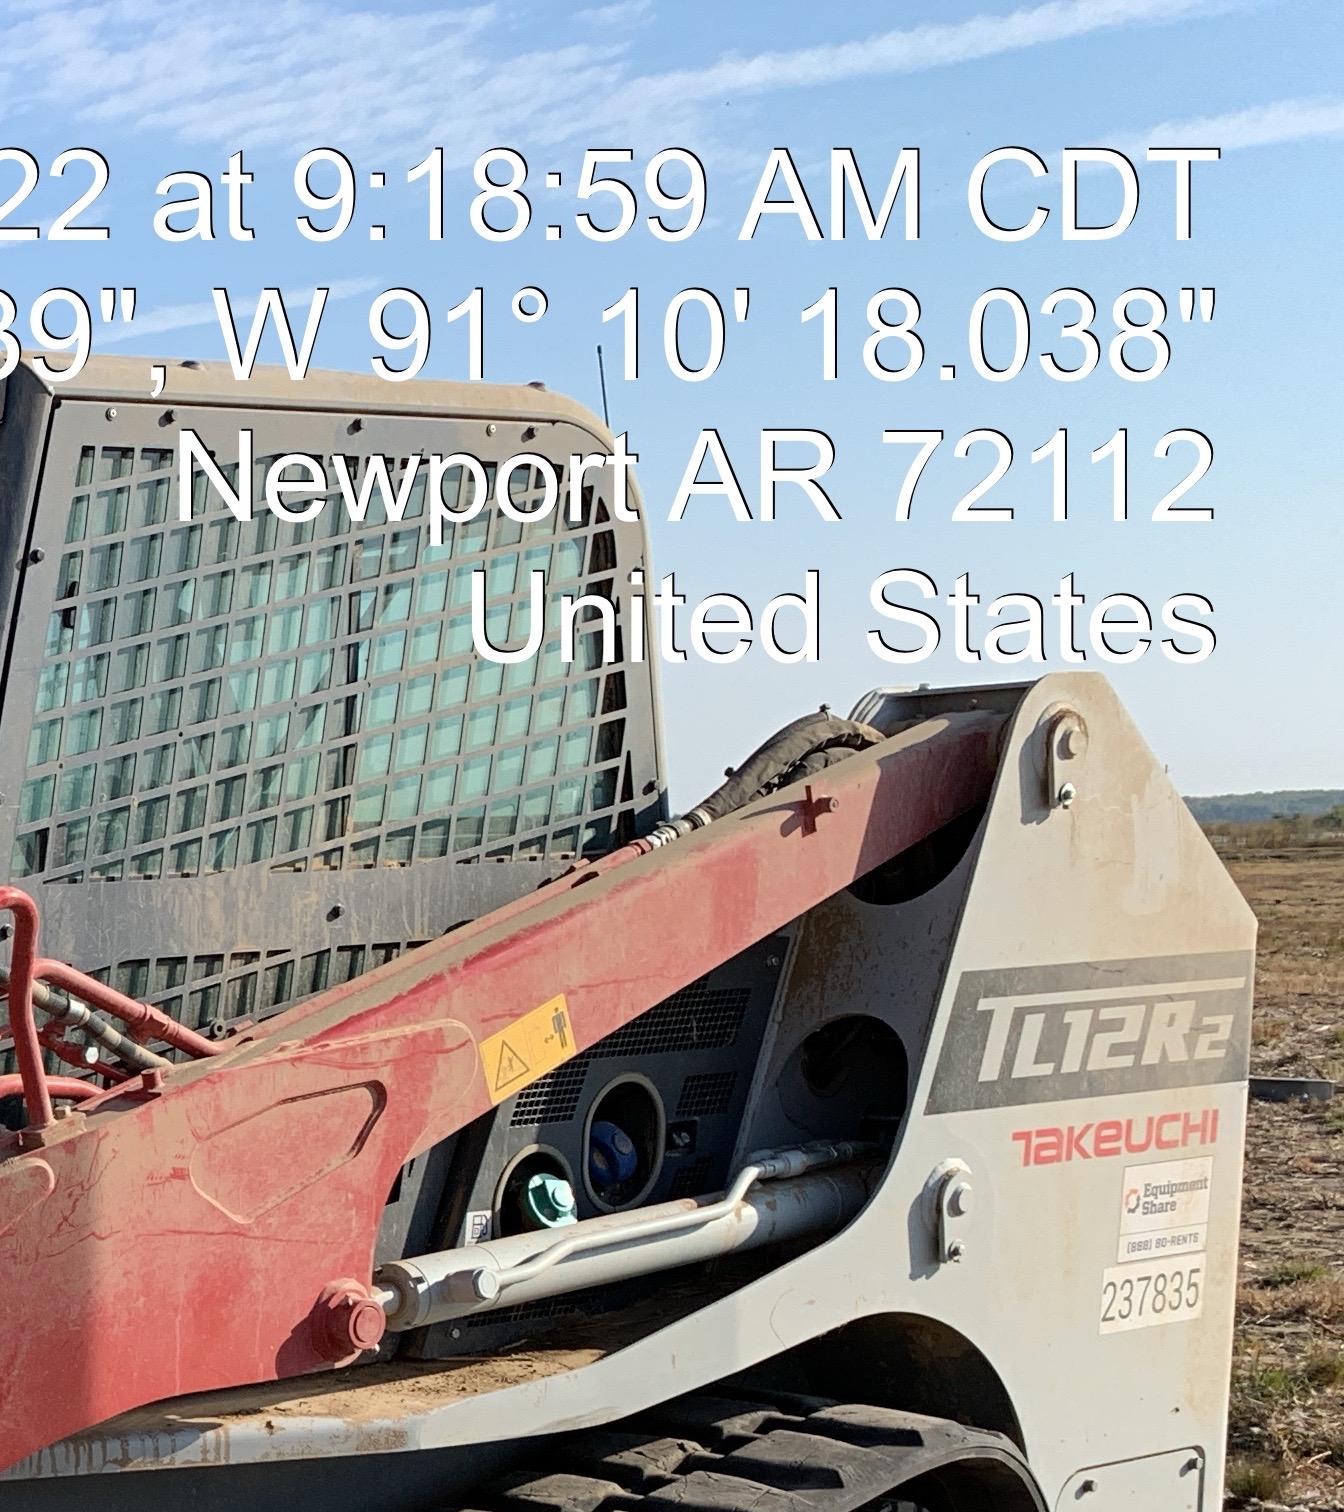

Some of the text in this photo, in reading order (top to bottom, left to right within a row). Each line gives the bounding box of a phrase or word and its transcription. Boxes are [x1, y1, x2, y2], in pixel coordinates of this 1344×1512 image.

[977, 976, 1246, 1083] TL12R2
[1011, 1109, 1220, 1168] TAKEUCHI
[1141, 1199, 1177, 1216] Share
[1142, 1176, 1209, 1199] Equipment
[1101, 1267, 1201, 1323] 237835
